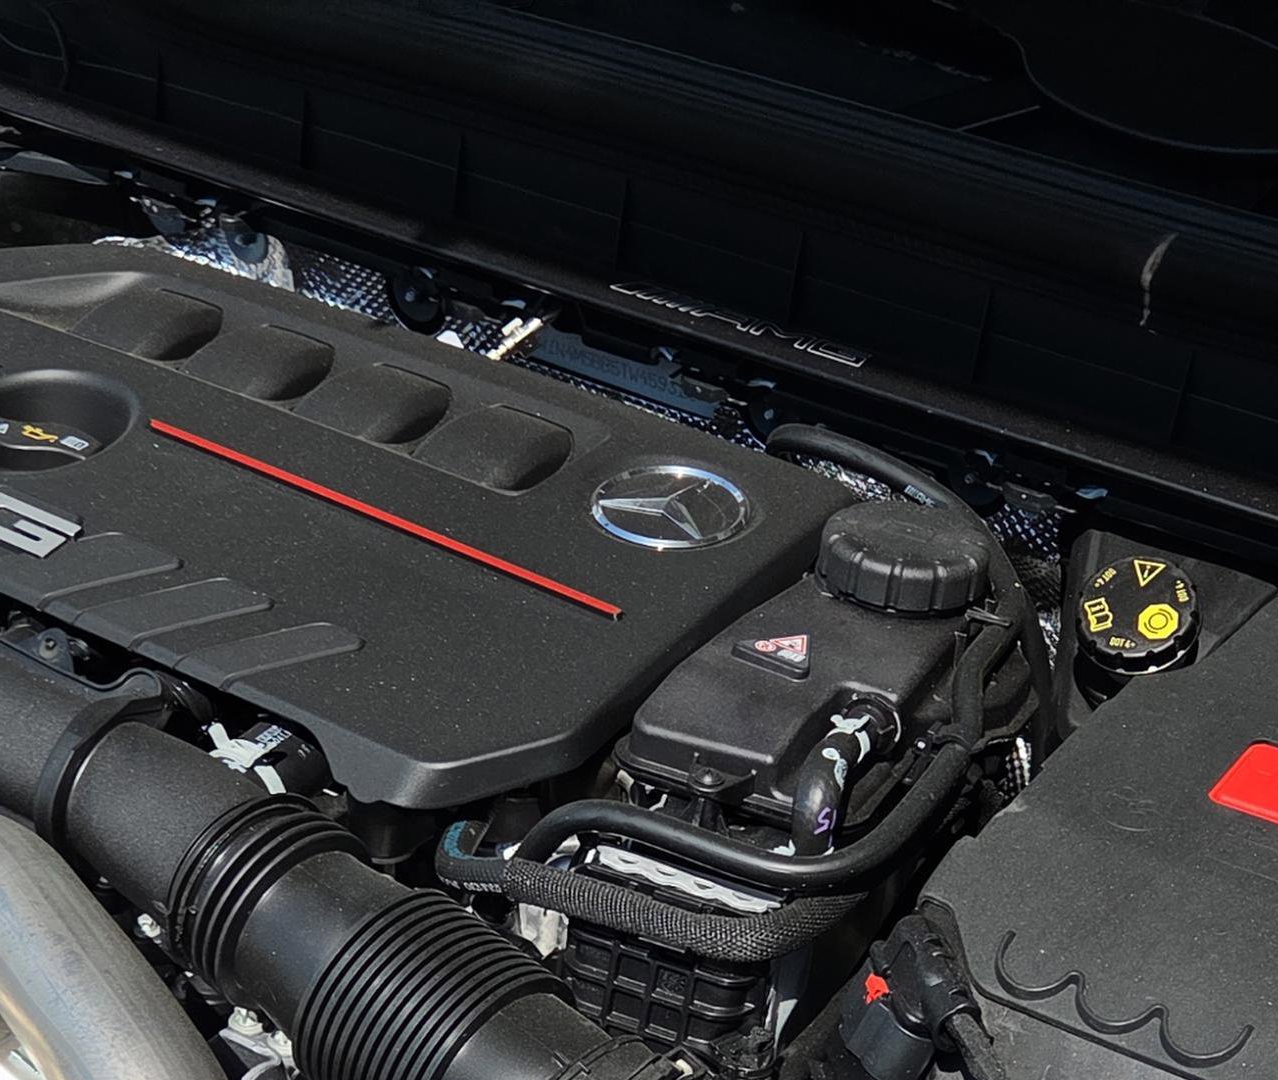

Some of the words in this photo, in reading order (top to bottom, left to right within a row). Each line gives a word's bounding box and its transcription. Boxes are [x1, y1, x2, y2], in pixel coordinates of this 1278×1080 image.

[1101, 567, 1118, 582] DOT
[1175, 589, 1190, 603] DOT
[1108, 636, 1125, 648] DOT
